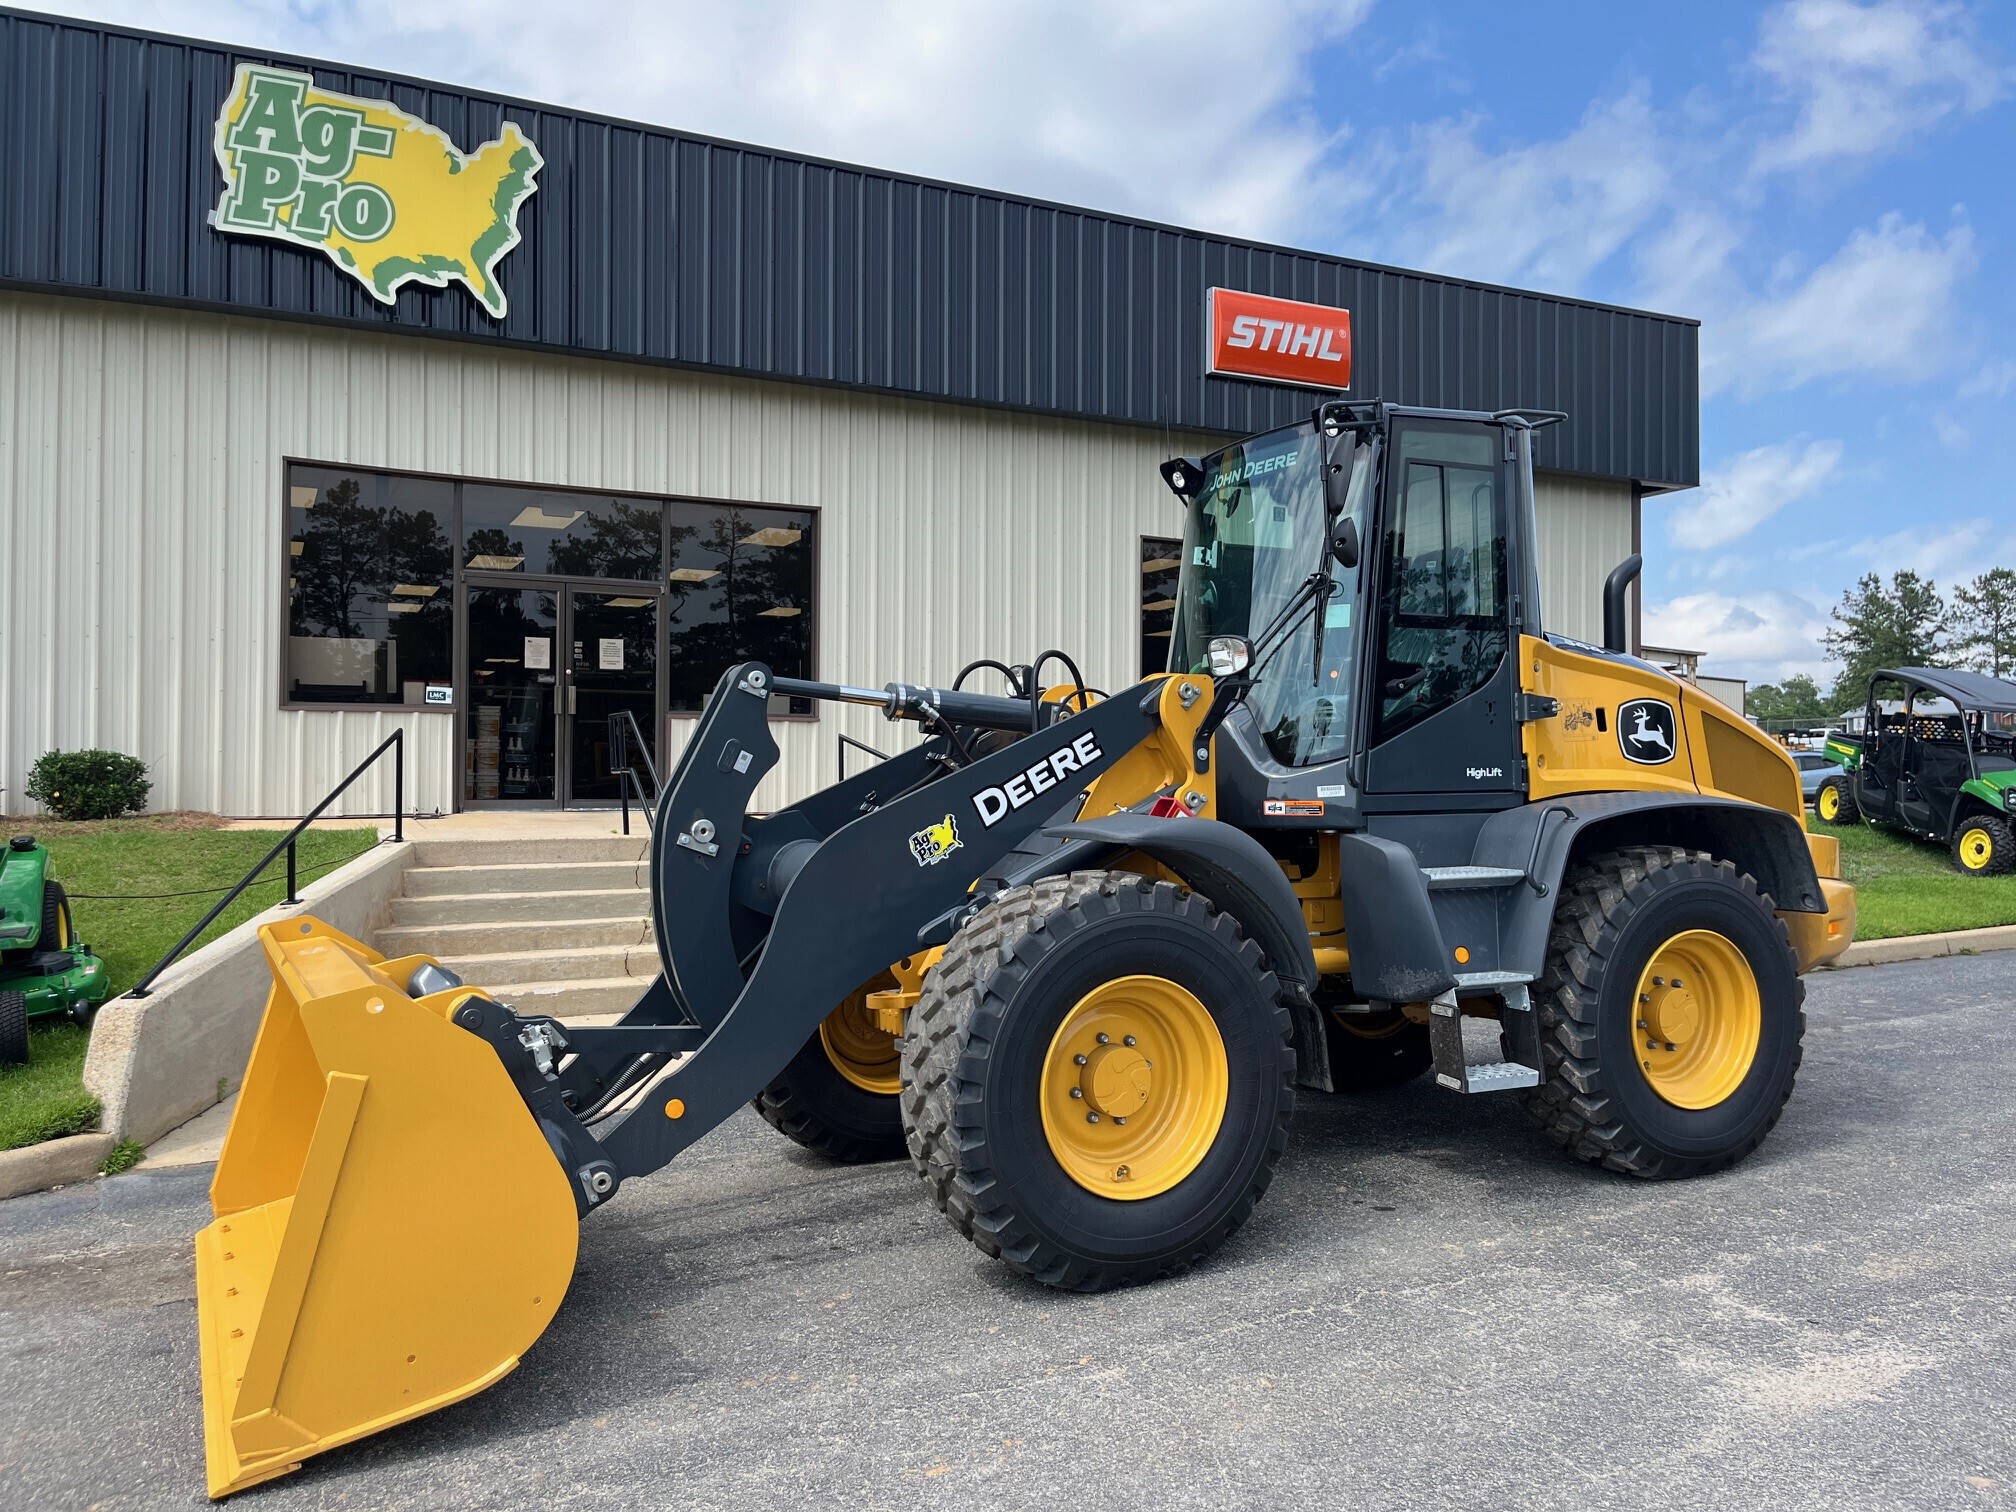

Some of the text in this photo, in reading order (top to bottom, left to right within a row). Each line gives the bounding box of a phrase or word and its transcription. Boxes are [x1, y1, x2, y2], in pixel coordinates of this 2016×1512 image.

[231, 75, 392, 178] Ag-
[228, 150, 392, 239] Pro
[1227, 315, 1342, 361] STIHL
[1210, 451, 1298, 491] JOHN DEERE
[972, 731, 1102, 827] DEERE
[911, 832, 933, 850] Ag-
[917, 841, 940, 862] Pro
